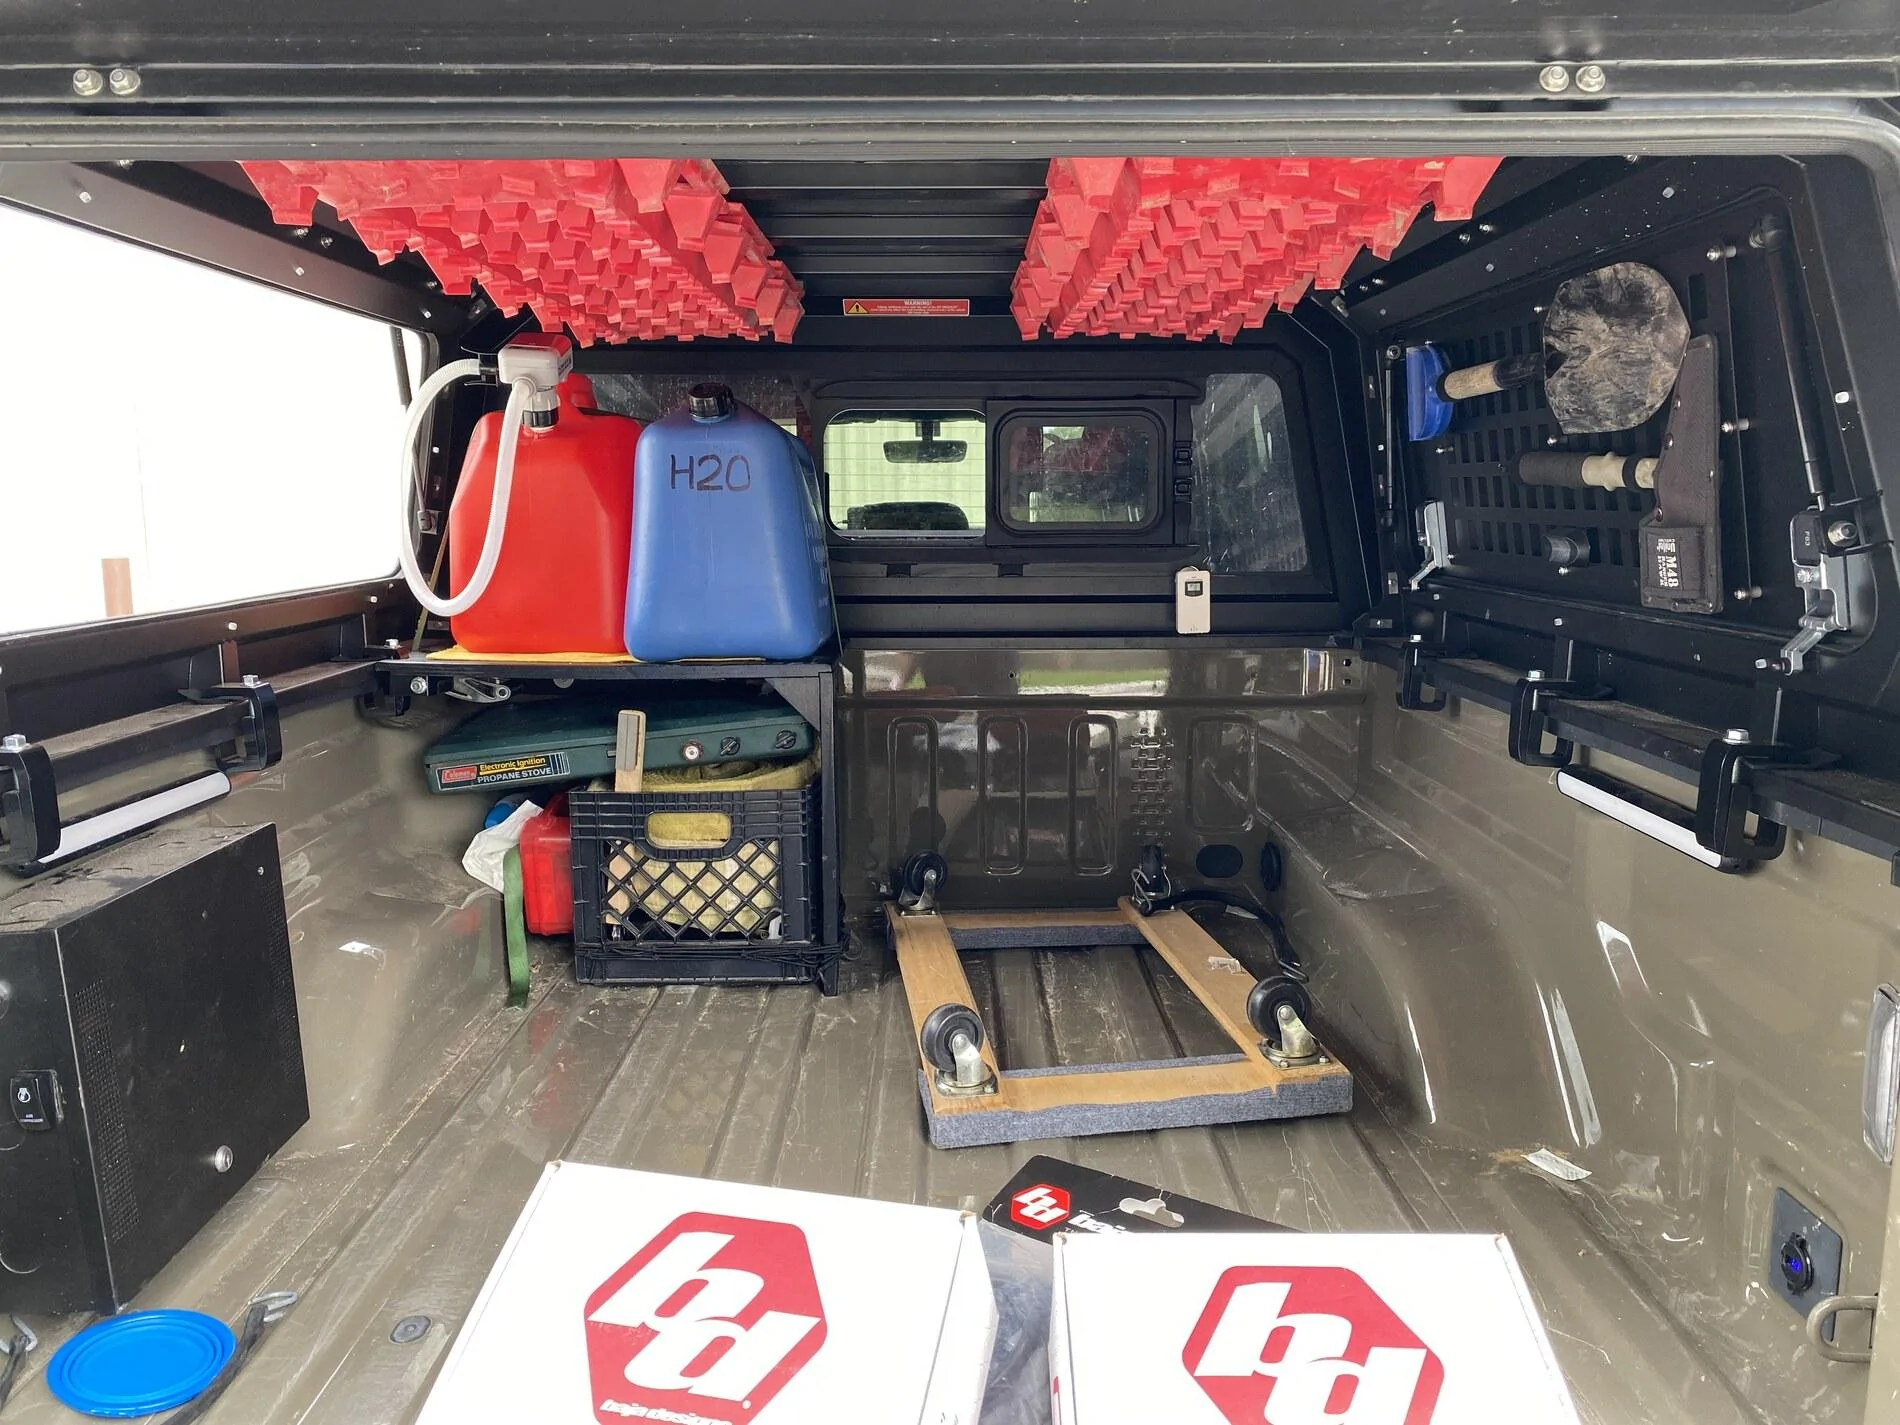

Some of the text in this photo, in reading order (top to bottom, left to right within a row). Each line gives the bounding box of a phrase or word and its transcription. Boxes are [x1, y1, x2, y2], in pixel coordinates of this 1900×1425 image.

[1665, 555, 1679, 588] M48
[479, 756, 546, 772] Electronic Ignition
[477, 767, 552, 783] PROPANE STOVE
